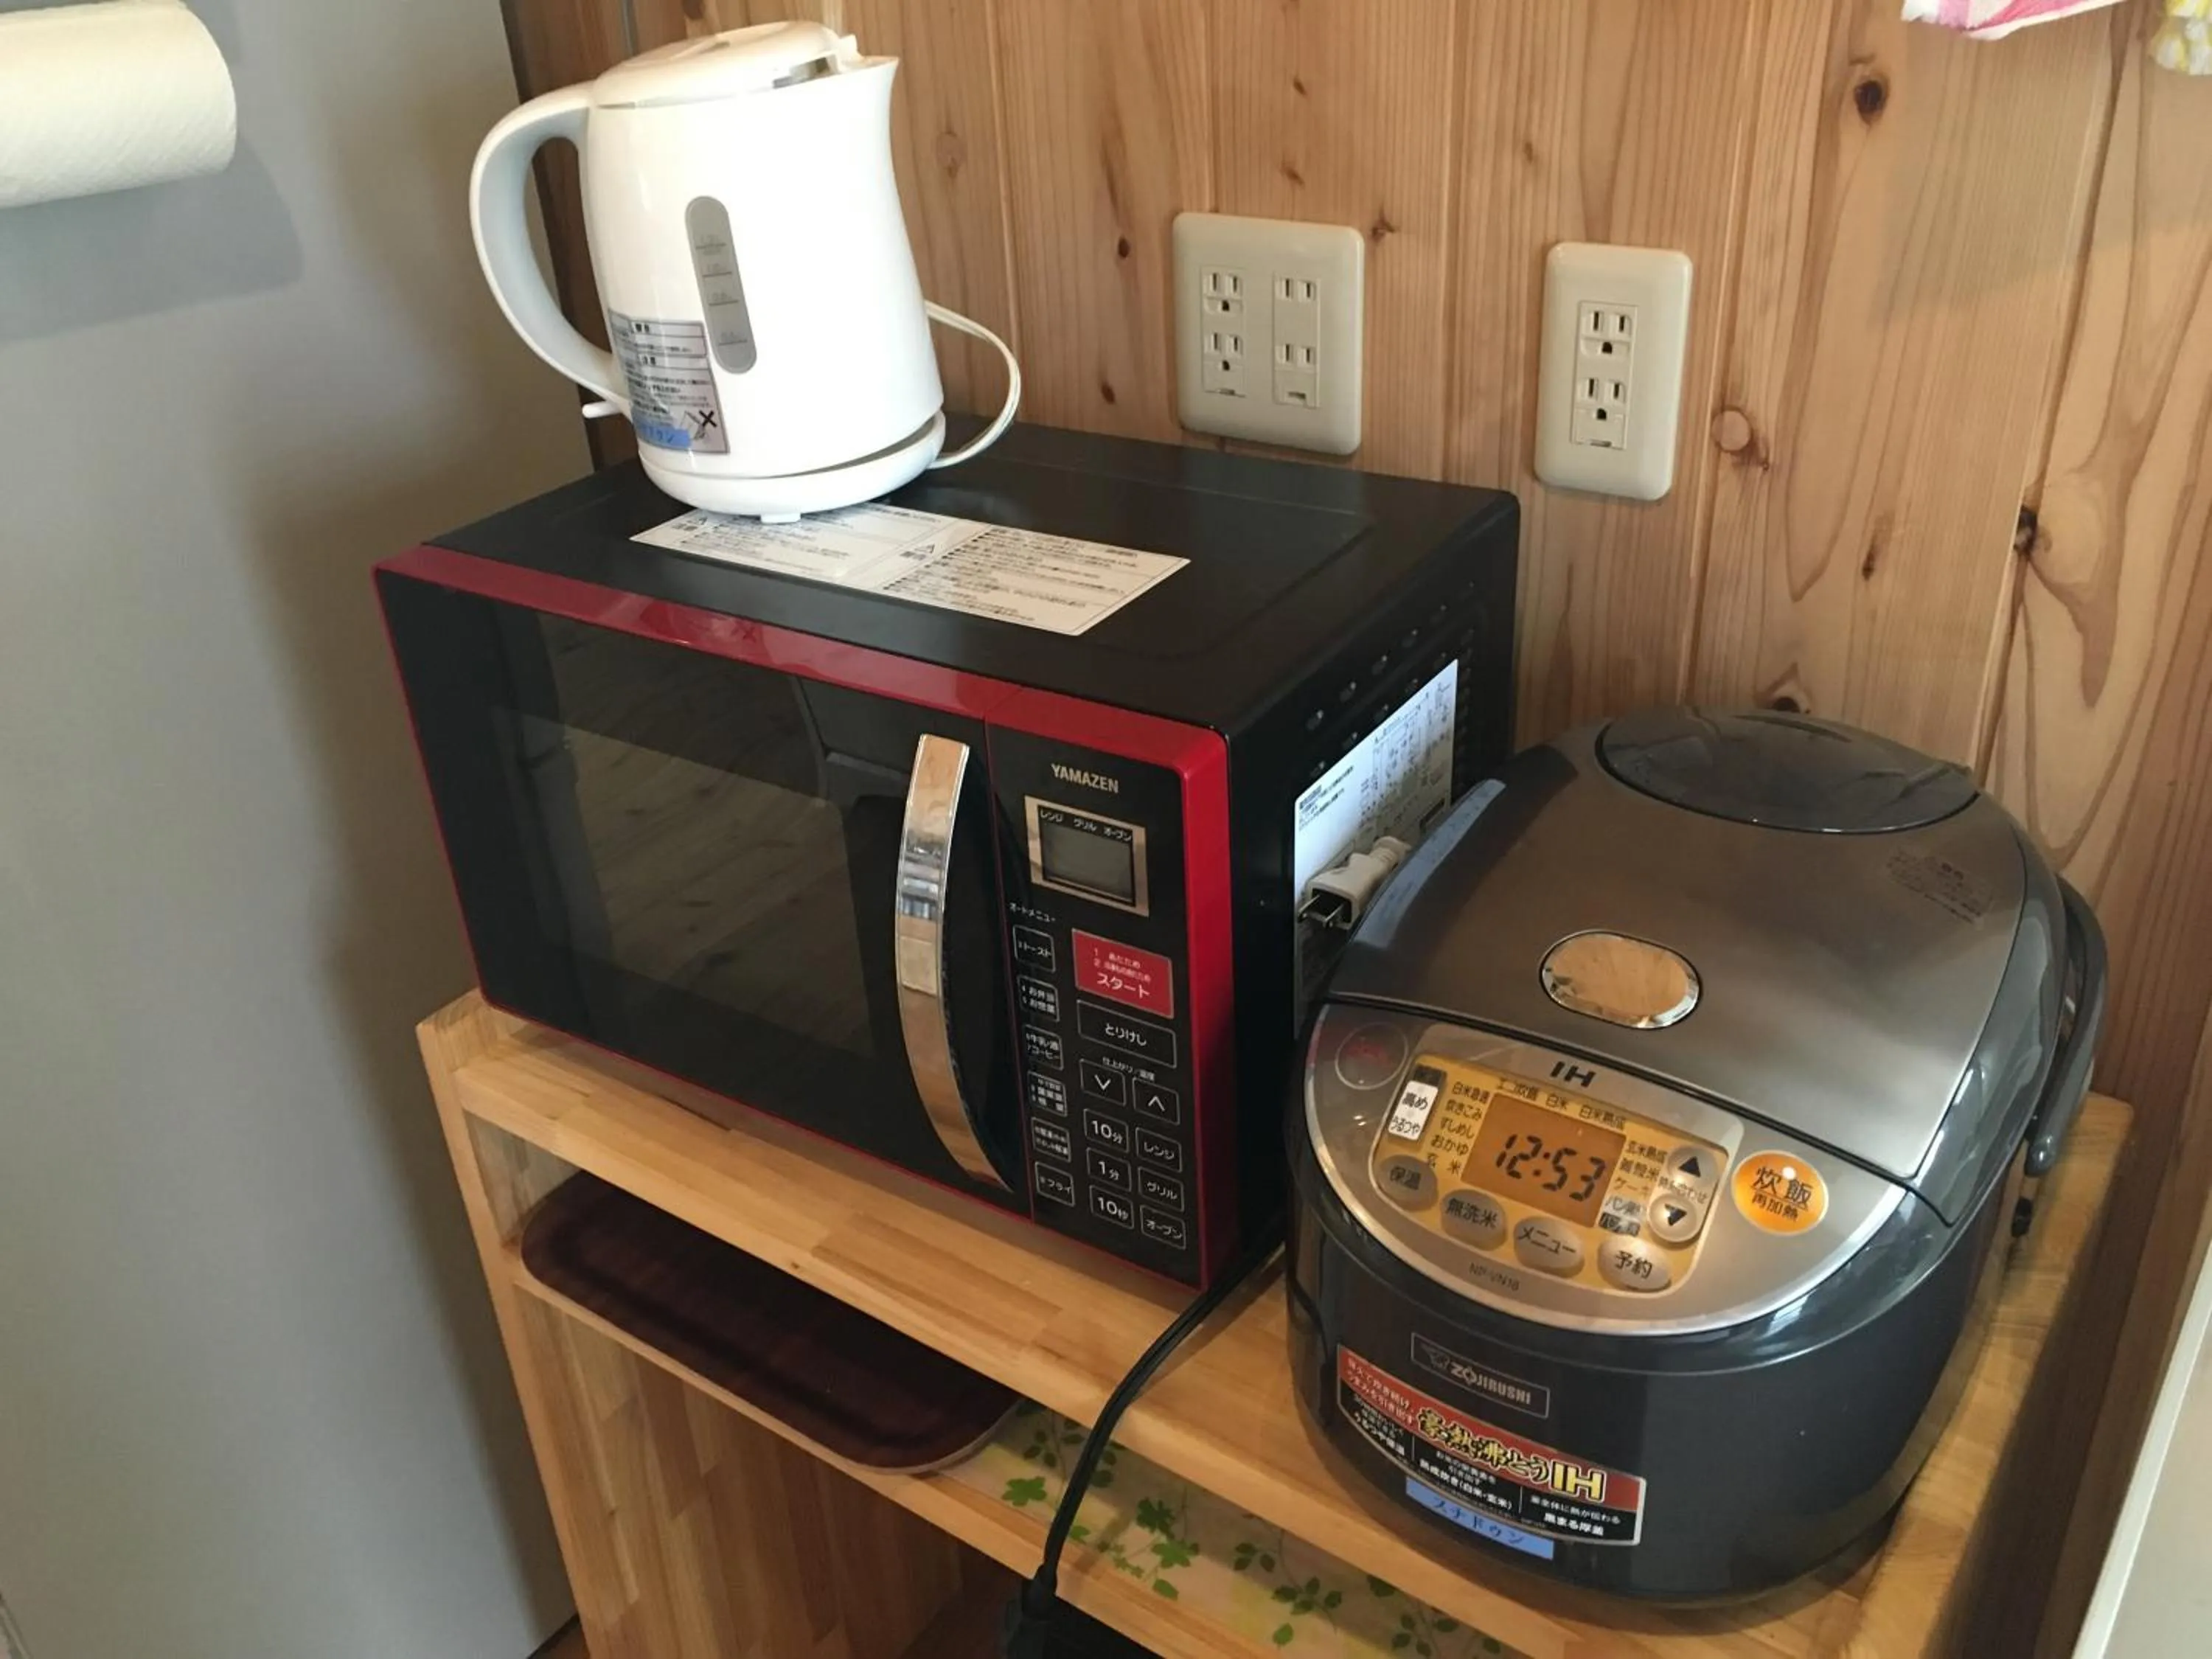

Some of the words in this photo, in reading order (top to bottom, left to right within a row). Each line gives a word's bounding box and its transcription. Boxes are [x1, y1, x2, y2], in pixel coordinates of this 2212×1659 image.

[1051, 763, 1119, 794] YAMAZEN
[1096, 971, 1150, 999] スタート
[1105, 1023, 1147, 1046] とりけし
[1550, 1061, 1596, 1088] IH
[1545, 1093, 1569, 1110] 白米
[1091, 1119, 1124, 1145] 10分
[1390, 1116, 1421, 1135] うるつや
[1440, 1116, 1475, 1139] すしめし
[1143, 1141, 1175, 1161] レンジ
[1430, 1135, 1470, 1156] おかゆ
[1097, 1160, 1120, 1181] 1分
[1389, 1166, 1422, 1191] 保温
[1495, 1134, 1607, 1203] 12:53
[1146, 1181, 1178, 1201] グリル
[1613, 1177, 1649, 1200] ケーキ
[1750, 1166, 1814, 1211] 炊飯
[1096, 1196, 1129, 1221] 10秒
[1445, 1197, 1498, 1229] 無洗米
[1752, 1194, 1799, 1222] 再加熱
[1517, 1226, 1577, 1255] メニュー
[1615, 1251, 1653, 1279] 予約
[1450, 1361, 1531, 1405] ZOJIRUSHI
